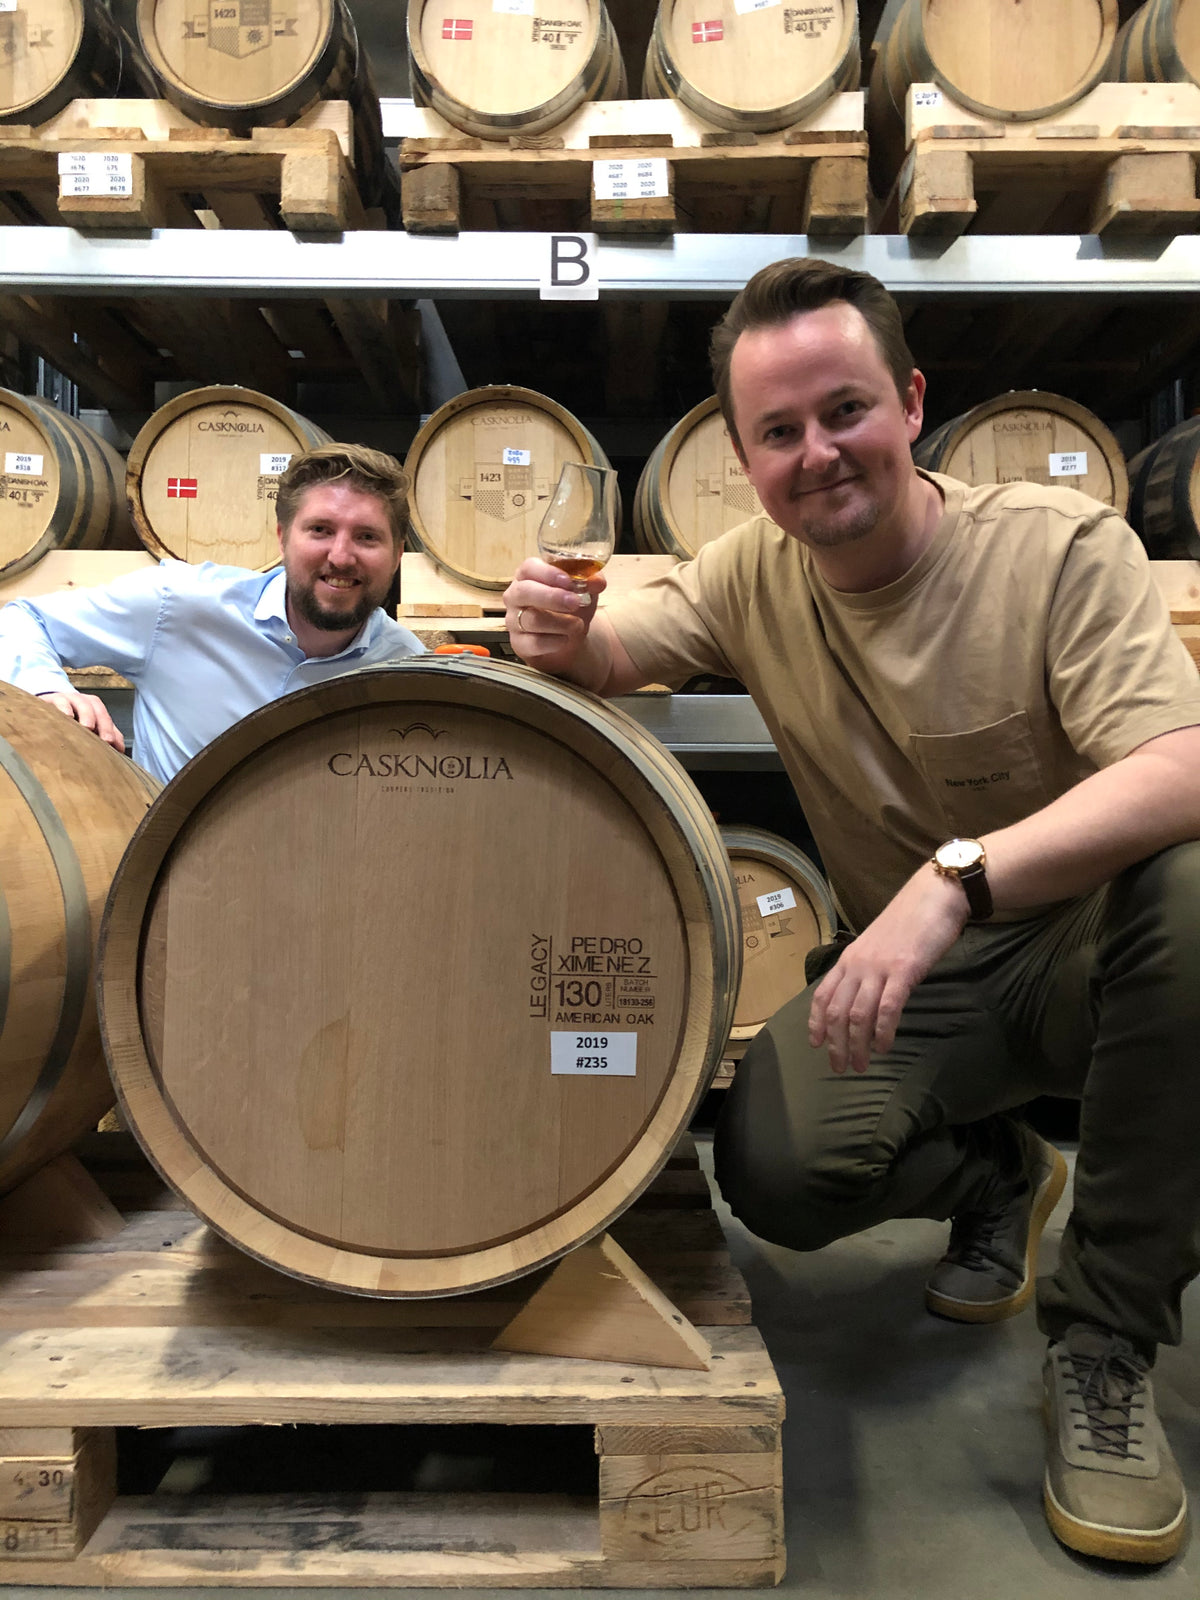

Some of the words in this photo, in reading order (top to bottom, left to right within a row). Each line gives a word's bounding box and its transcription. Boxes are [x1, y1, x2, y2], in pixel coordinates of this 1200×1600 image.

[795, 22, 807, 32] 40
[542, 33, 554, 43] 40
[550, 235, 590, 286] B
[198, 421, 264, 433] CASKNOLIA
[480, 473, 501, 482] 1423
[729, 467, 746, 476] 142
[34, 479, 49, 487] OAK
[9, 491, 21, 501] 40
[327, 753, 514, 780] CASKNOLIA
[945, 778, 965, 787] New
[966, 777, 989, 786] York
[991, 771, 1010, 782] City
[767, 893, 782, 903] 2019
[571, 937, 643, 955] PEDRO
[557, 955, 651, 974] XIMENEZ
[530, 933, 548, 1018] LEGACY
[555, 980, 601, 1007] 130
[555, 1012, 620, 1024] AMERICAN
[626, 1013, 654, 1025] OAK
[576, 1037, 608, 1049] 2019
[576, 1056, 608, 1069] #235
[38, 1470, 64, 1487] 30
[654, 1481, 727, 1535] EUR
